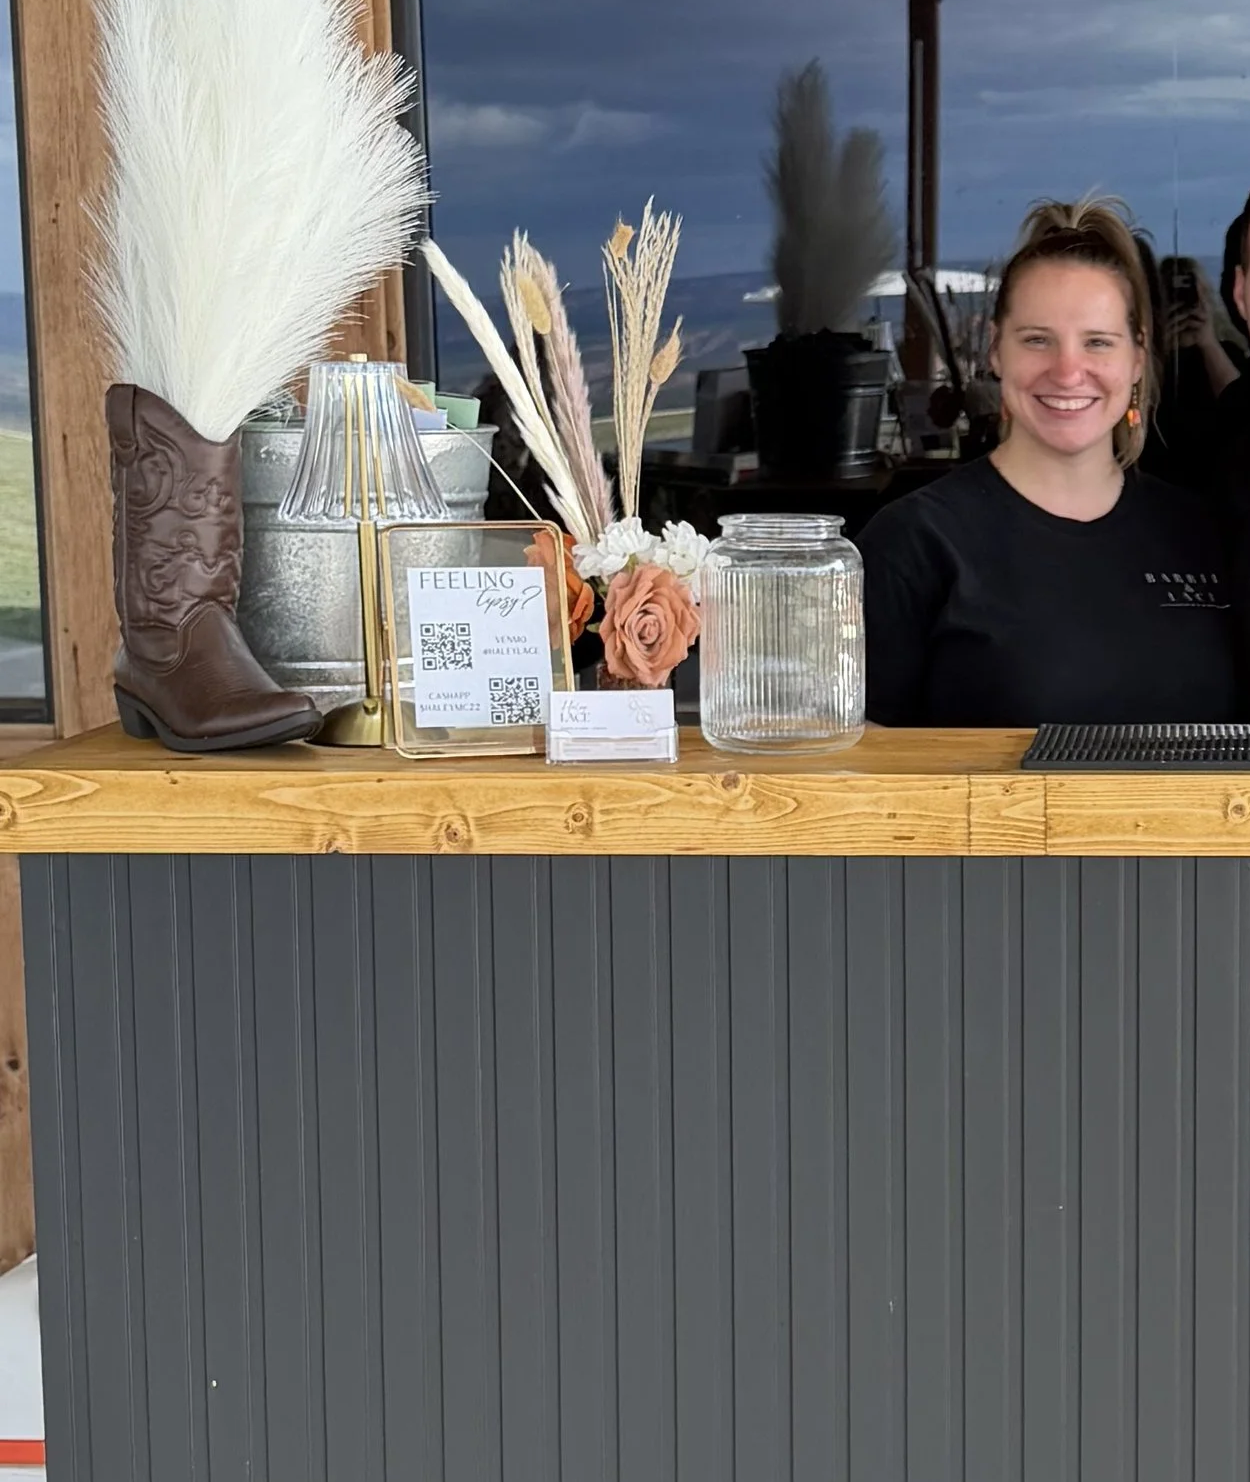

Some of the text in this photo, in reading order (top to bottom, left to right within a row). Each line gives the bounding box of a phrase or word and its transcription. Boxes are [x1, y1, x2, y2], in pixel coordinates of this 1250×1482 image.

[419, 570, 515, 590] FEELING
[495, 635, 528, 644] VENMO
[428, 691, 471, 700] CASHAPP
